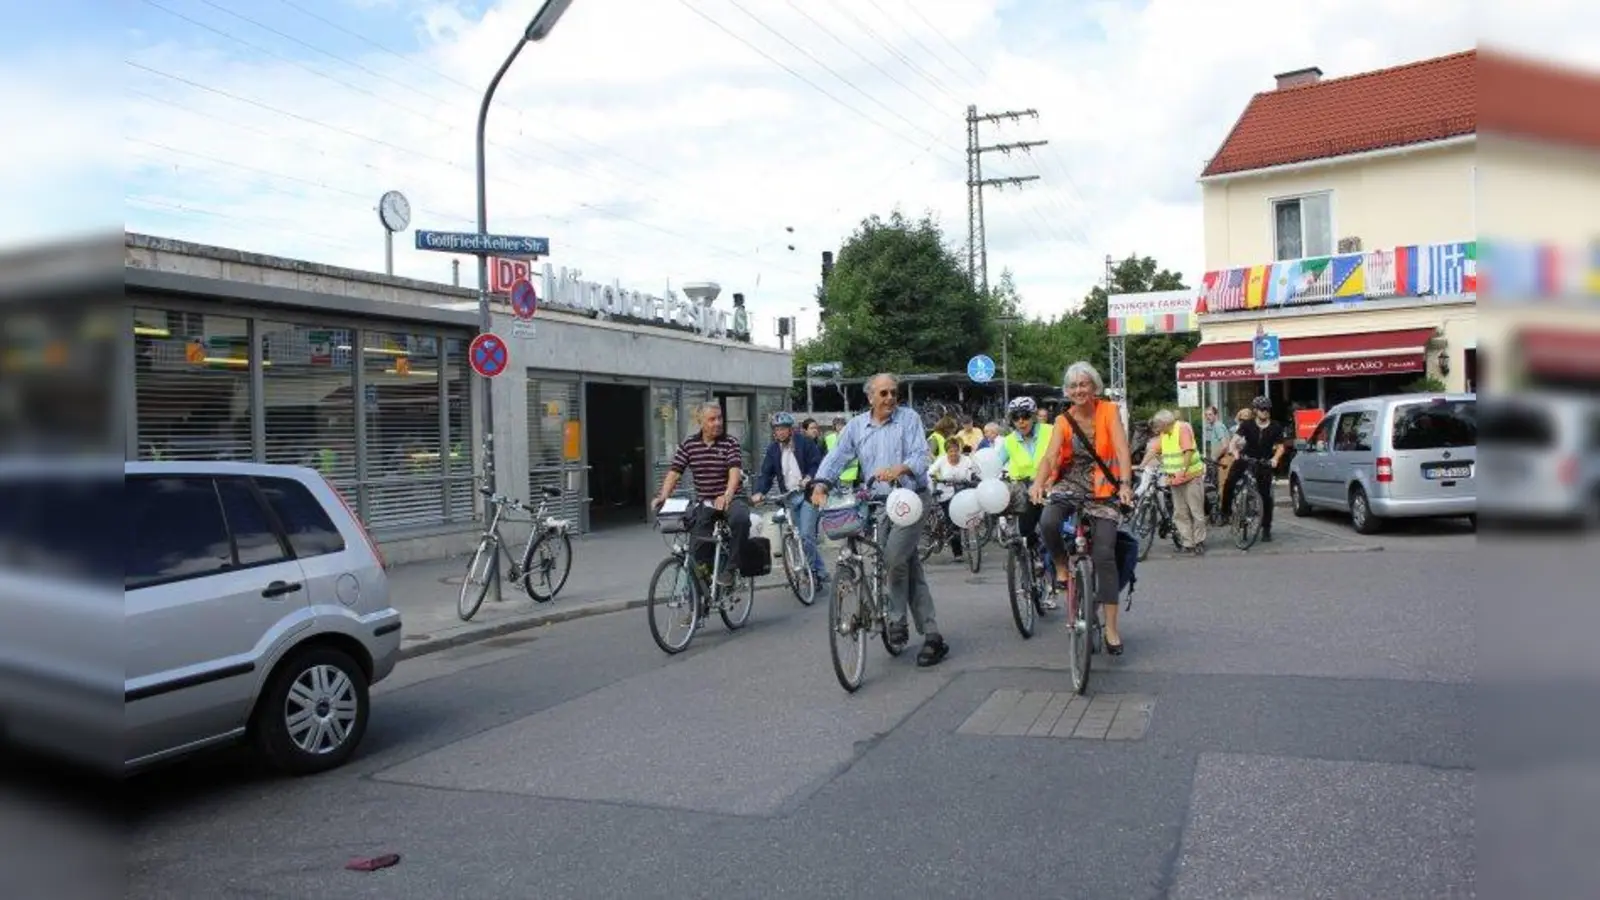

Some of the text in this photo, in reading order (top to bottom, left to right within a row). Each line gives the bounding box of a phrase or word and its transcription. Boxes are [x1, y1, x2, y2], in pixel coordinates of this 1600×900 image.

[426, 232, 544, 253] Gottfried-Keller-Str.
[500, 260, 527, 289] DB
[1336, 360, 1384, 371] BACARO
